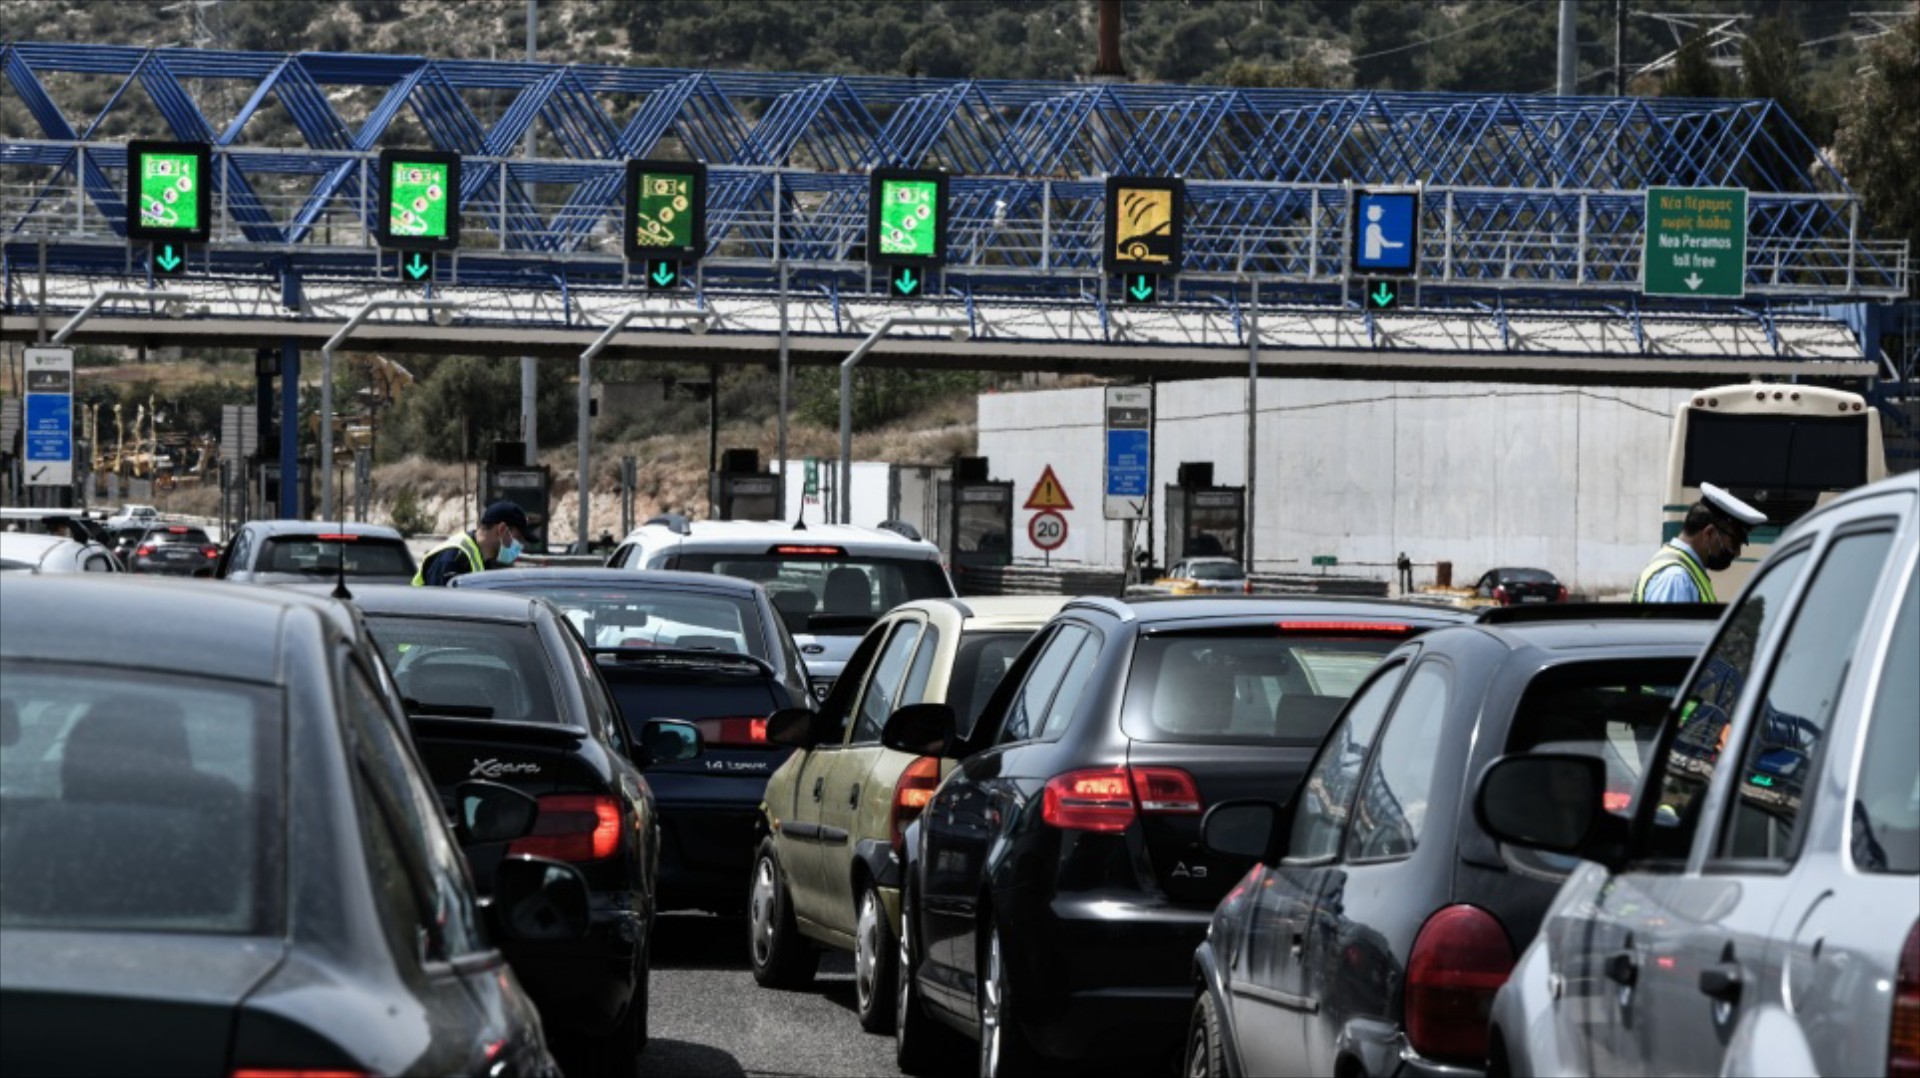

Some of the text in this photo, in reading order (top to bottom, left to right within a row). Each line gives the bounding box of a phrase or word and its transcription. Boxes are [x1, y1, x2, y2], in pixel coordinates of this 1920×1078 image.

[1659, 233, 1732, 249] Nea Peramos
[1672, 252, 1716, 267] toll free
[1037, 521, 1060, 537] 20
[1171, 861, 1207, 877] A3
